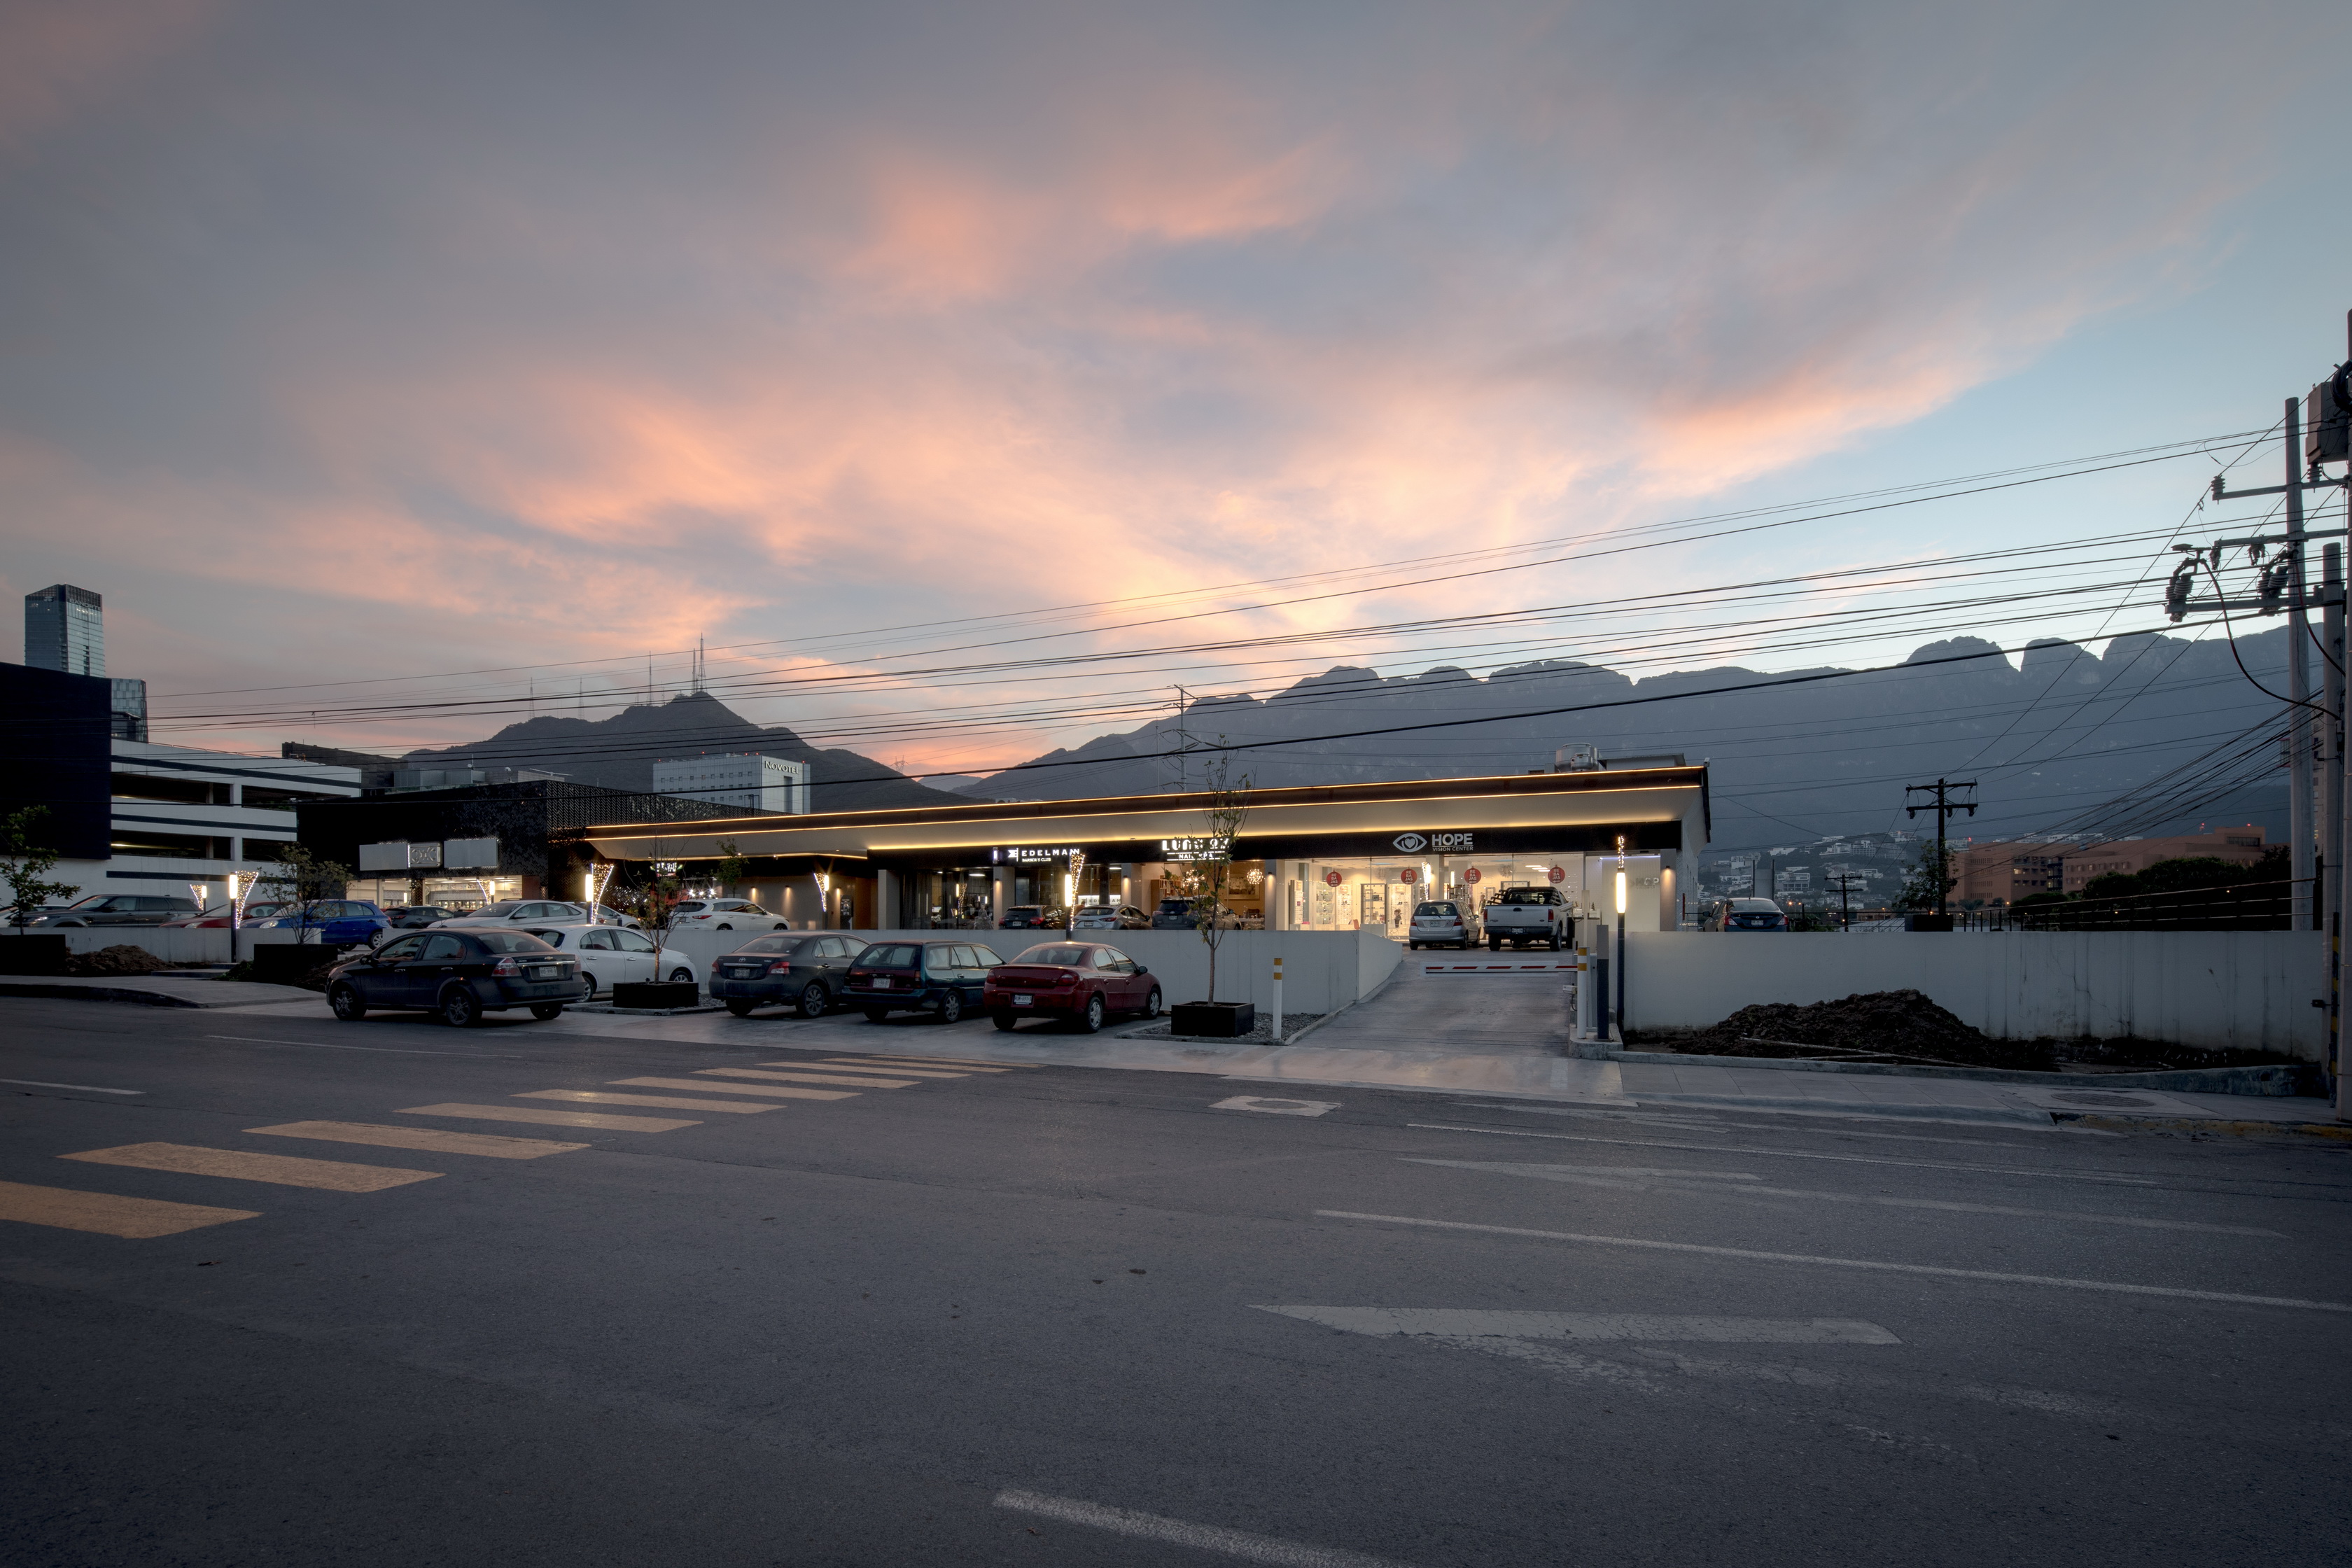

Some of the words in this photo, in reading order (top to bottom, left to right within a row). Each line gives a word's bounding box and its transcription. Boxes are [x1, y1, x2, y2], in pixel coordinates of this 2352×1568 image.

[69, 598, 102, 610] BANORTE
[764, 760, 799, 774] NOVOTEL
[1432, 833, 1474, 846] HOPE
[1021, 848, 1080, 857] EDELMANN
